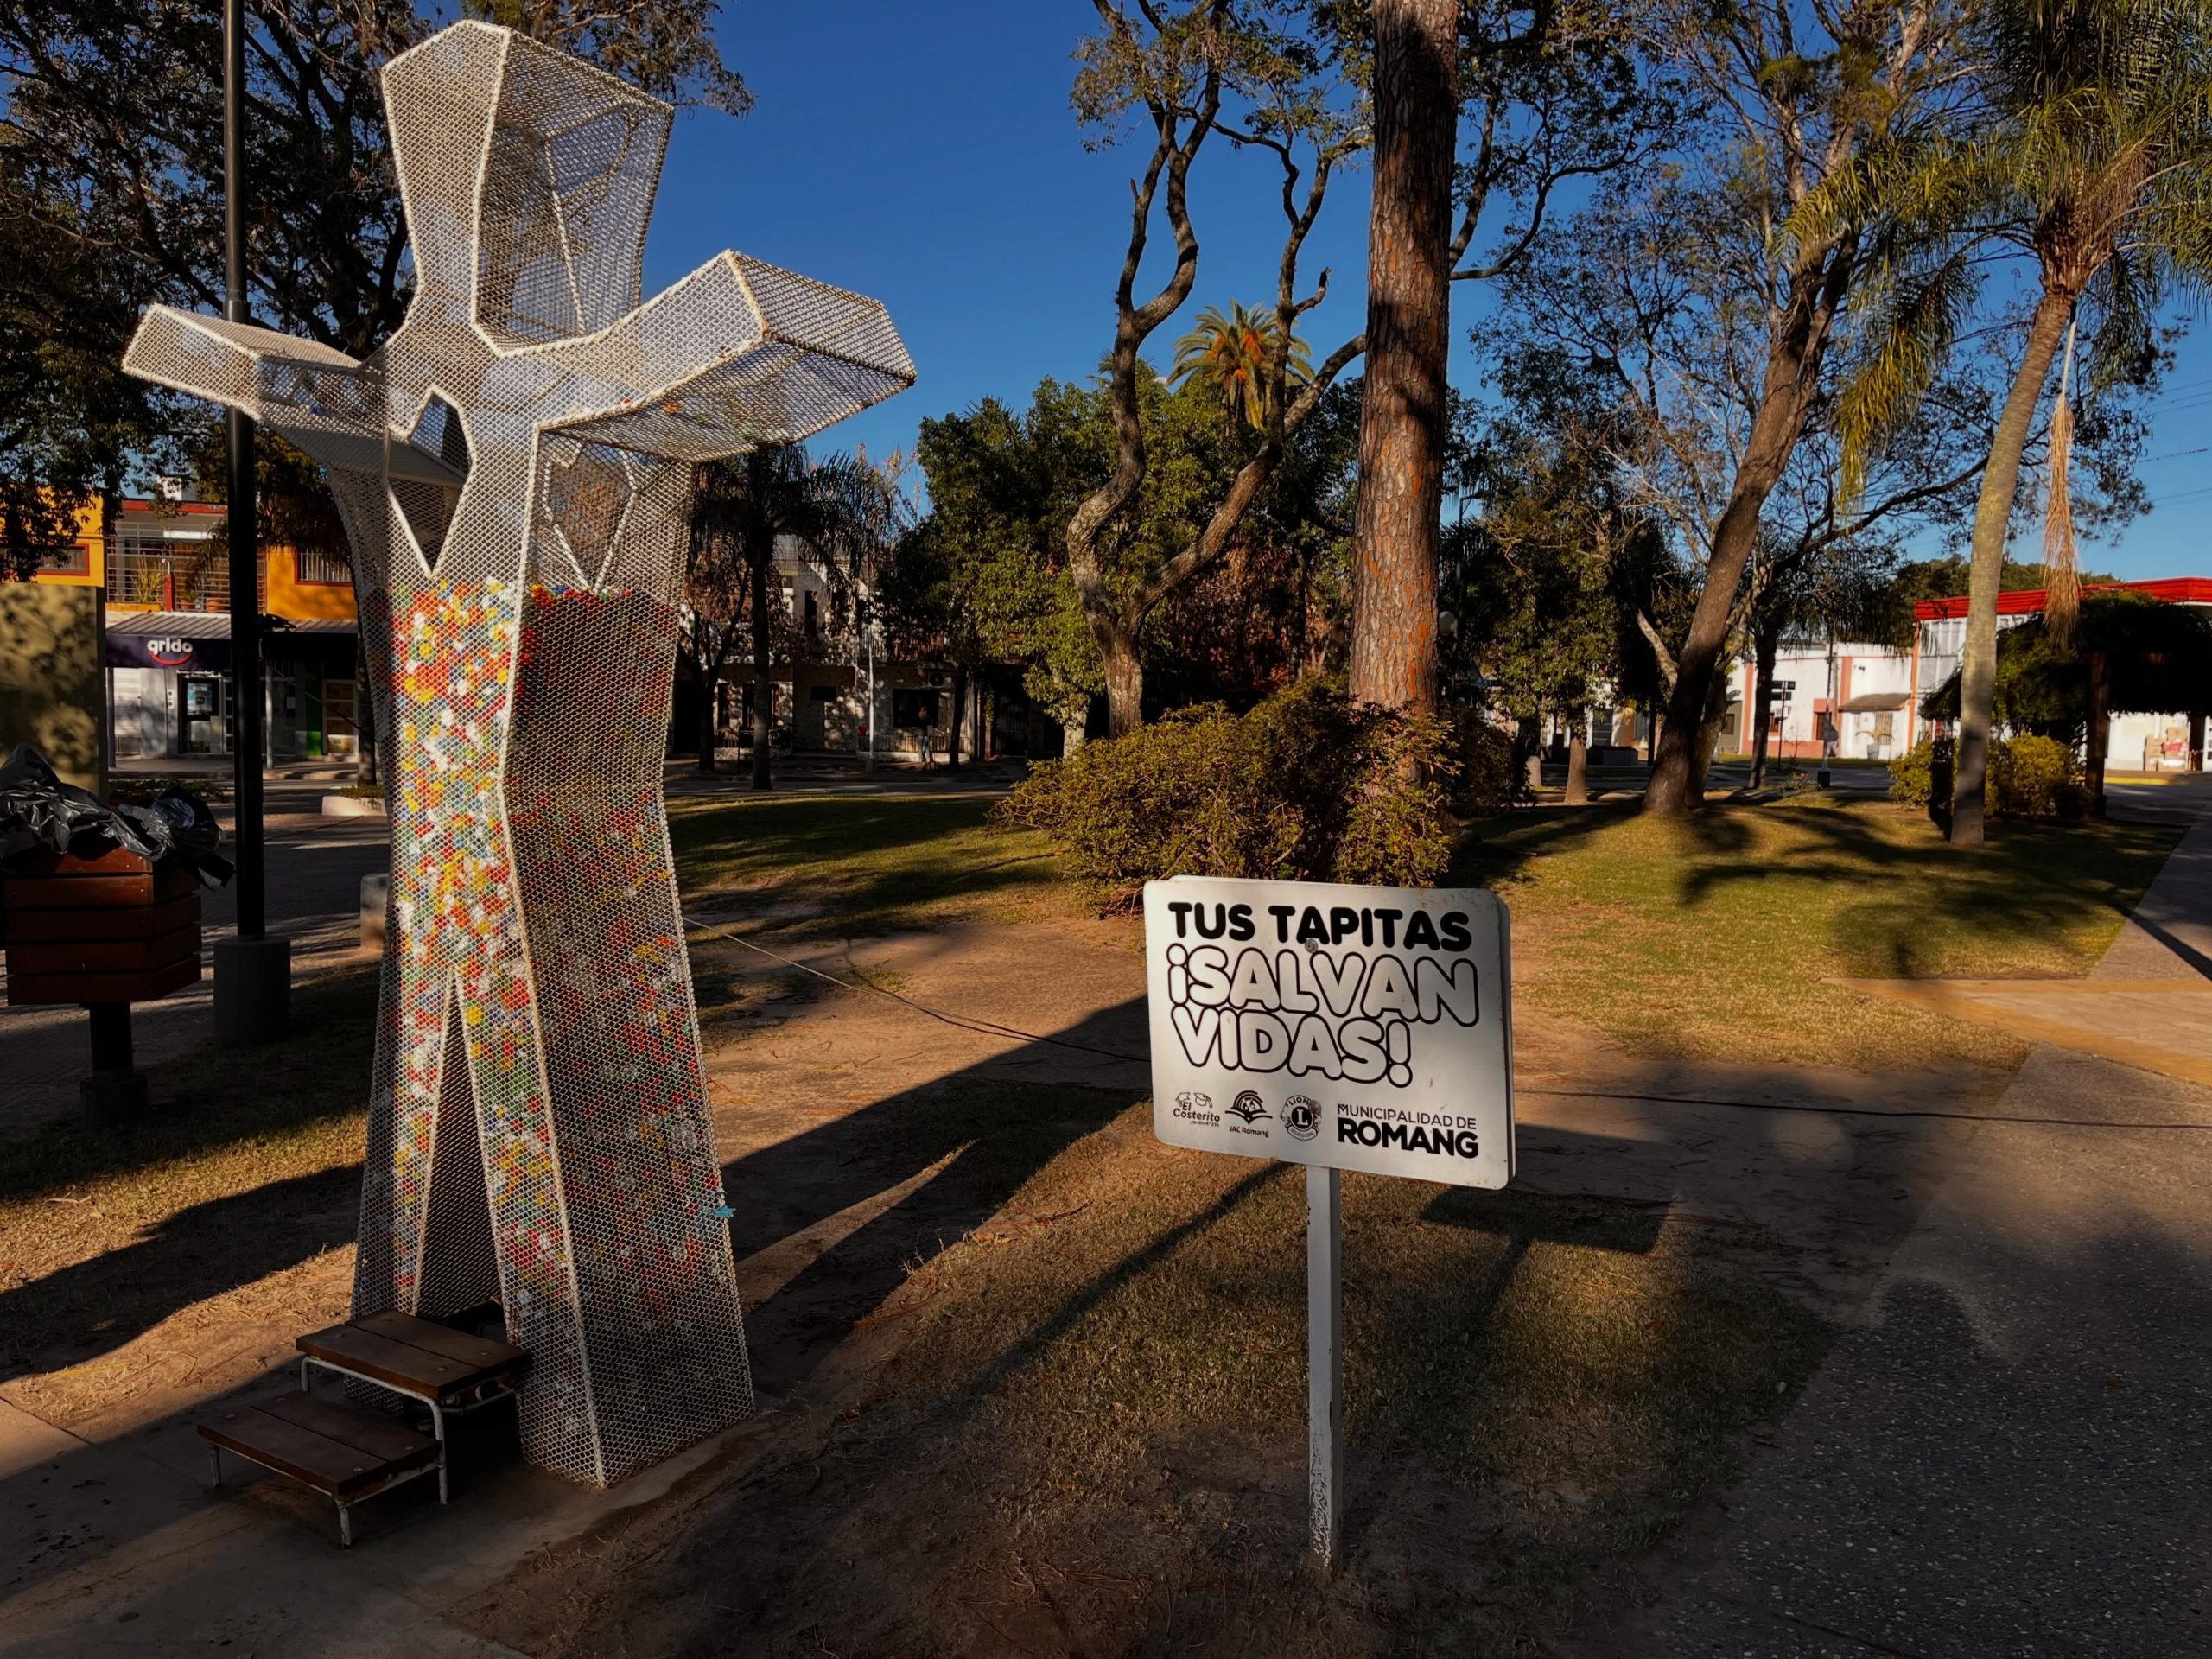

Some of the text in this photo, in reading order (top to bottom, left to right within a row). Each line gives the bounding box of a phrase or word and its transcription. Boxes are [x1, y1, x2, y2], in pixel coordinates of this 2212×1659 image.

[147, 637, 194, 655] grido
[1167, 901, 1473, 952] TUS TAPITAS
[1166, 942, 1480, 1027] ¡SALVAN
[1171, 1004, 1413, 1089] VIDAS!
[1173, 1108, 1221, 1122] Costerito
[1182, 1101, 1192, 1111] El
[1296, 1109, 1309, 1125] L
[1338, 1103, 1477, 1130] MUNICIPALIDAD DE
[1242, 1128, 1270, 1138] Romang
[1338, 1117, 1479, 1159] ROMANG
